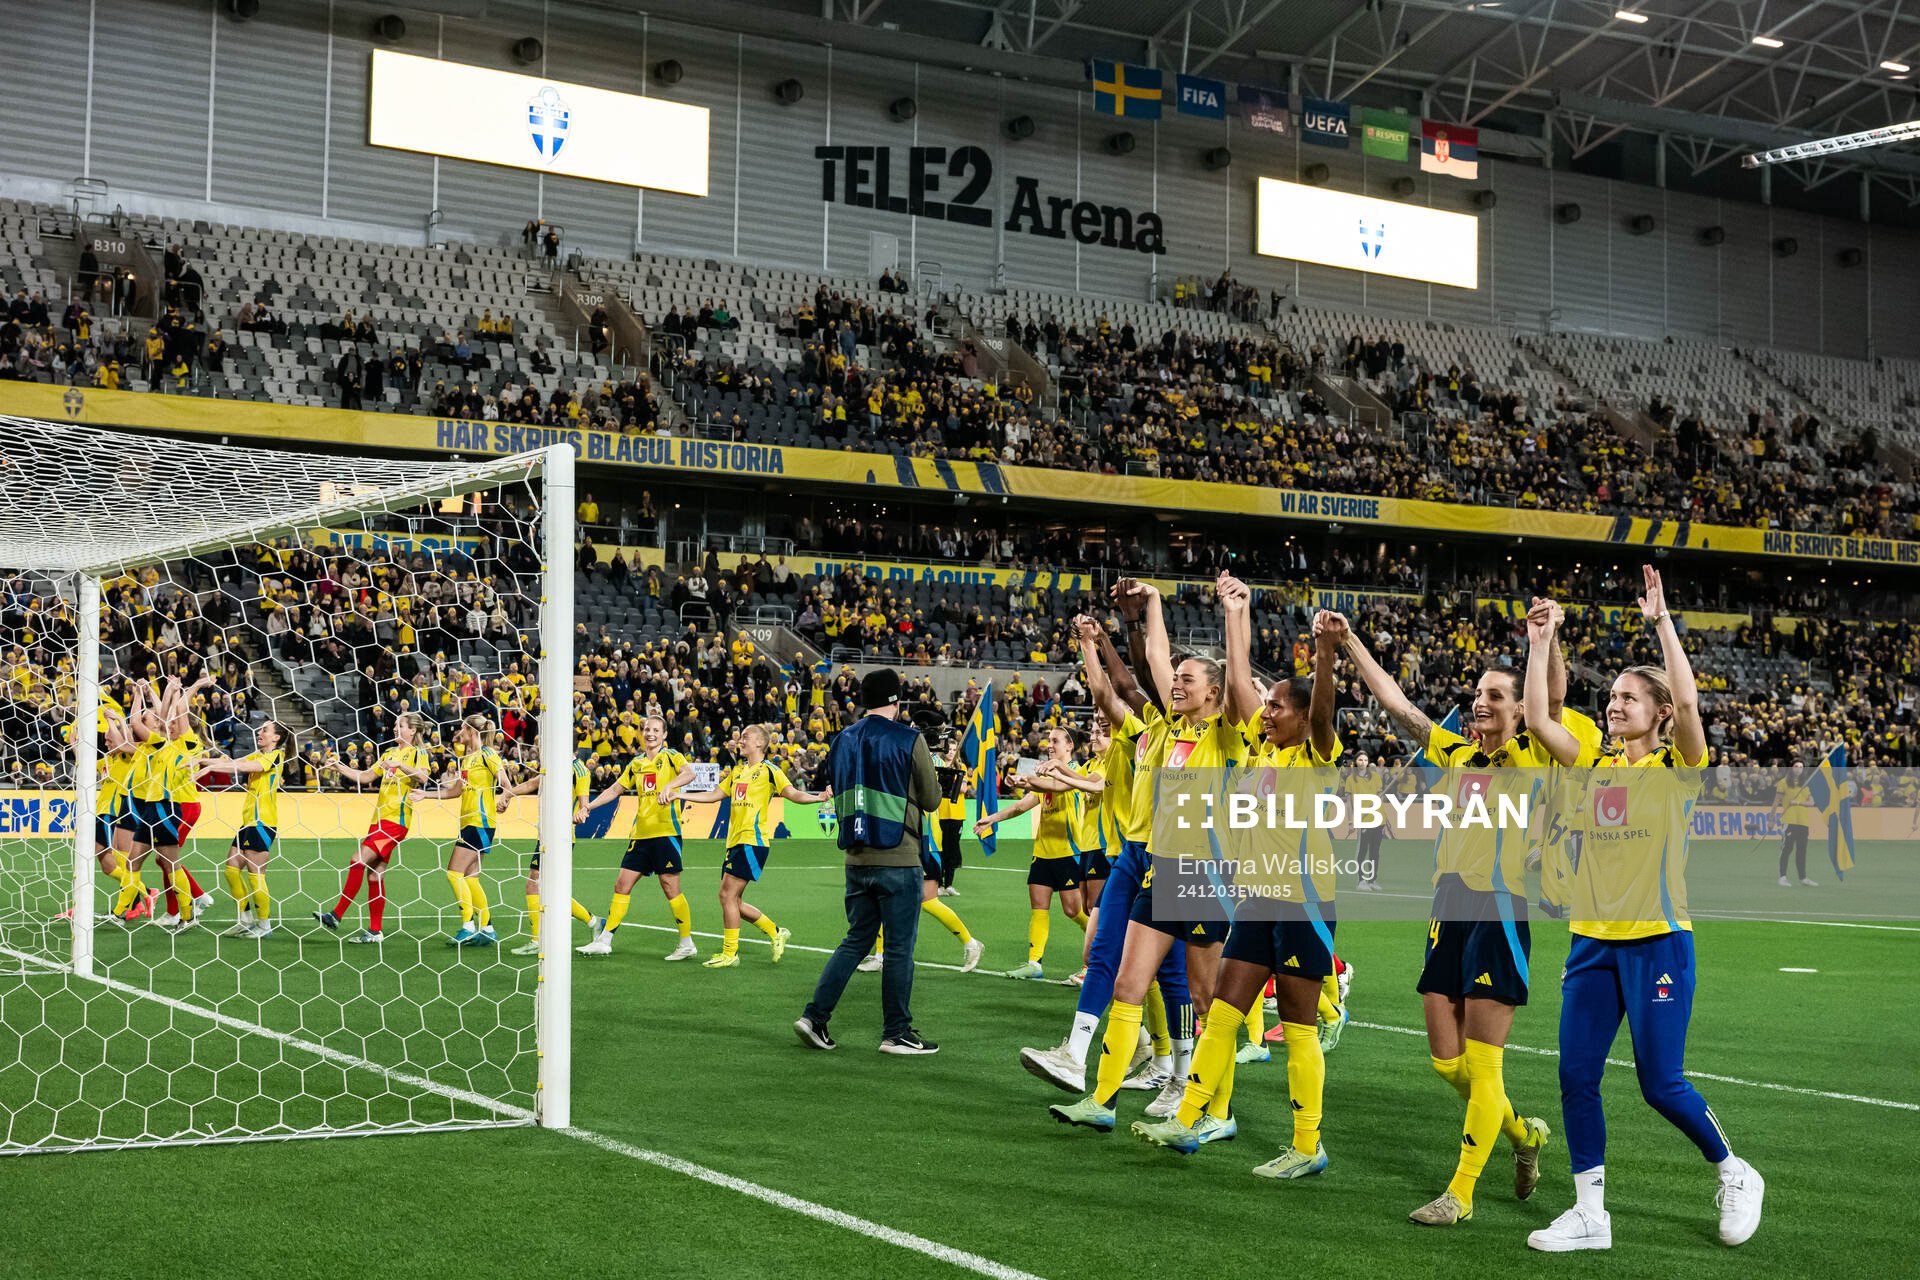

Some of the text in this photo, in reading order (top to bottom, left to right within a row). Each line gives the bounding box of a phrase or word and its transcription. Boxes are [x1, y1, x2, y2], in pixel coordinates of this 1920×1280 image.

[1183, 87, 1218, 108] FIFA
[1305, 111, 1347, 134] UEFA
[1375, 128, 1405, 143] RESPECT
[815, 145, 1167, 255] TELE2 Arena
[94, 239, 126, 254] B310
[436, 420, 488, 451] HÄR
[494, 424, 583, 458] SKRIVS
[680, 440, 784, 474] HISTORIA
[1280, 492, 1379, 519] VI ÄR SVERIGE
[1763, 531, 1792, 553] HÄR
[1794, 535, 1843, 558] SKRIVS
[1624, 829, 1651, 840] SPEL
[1719, 811, 1743, 836] EM
